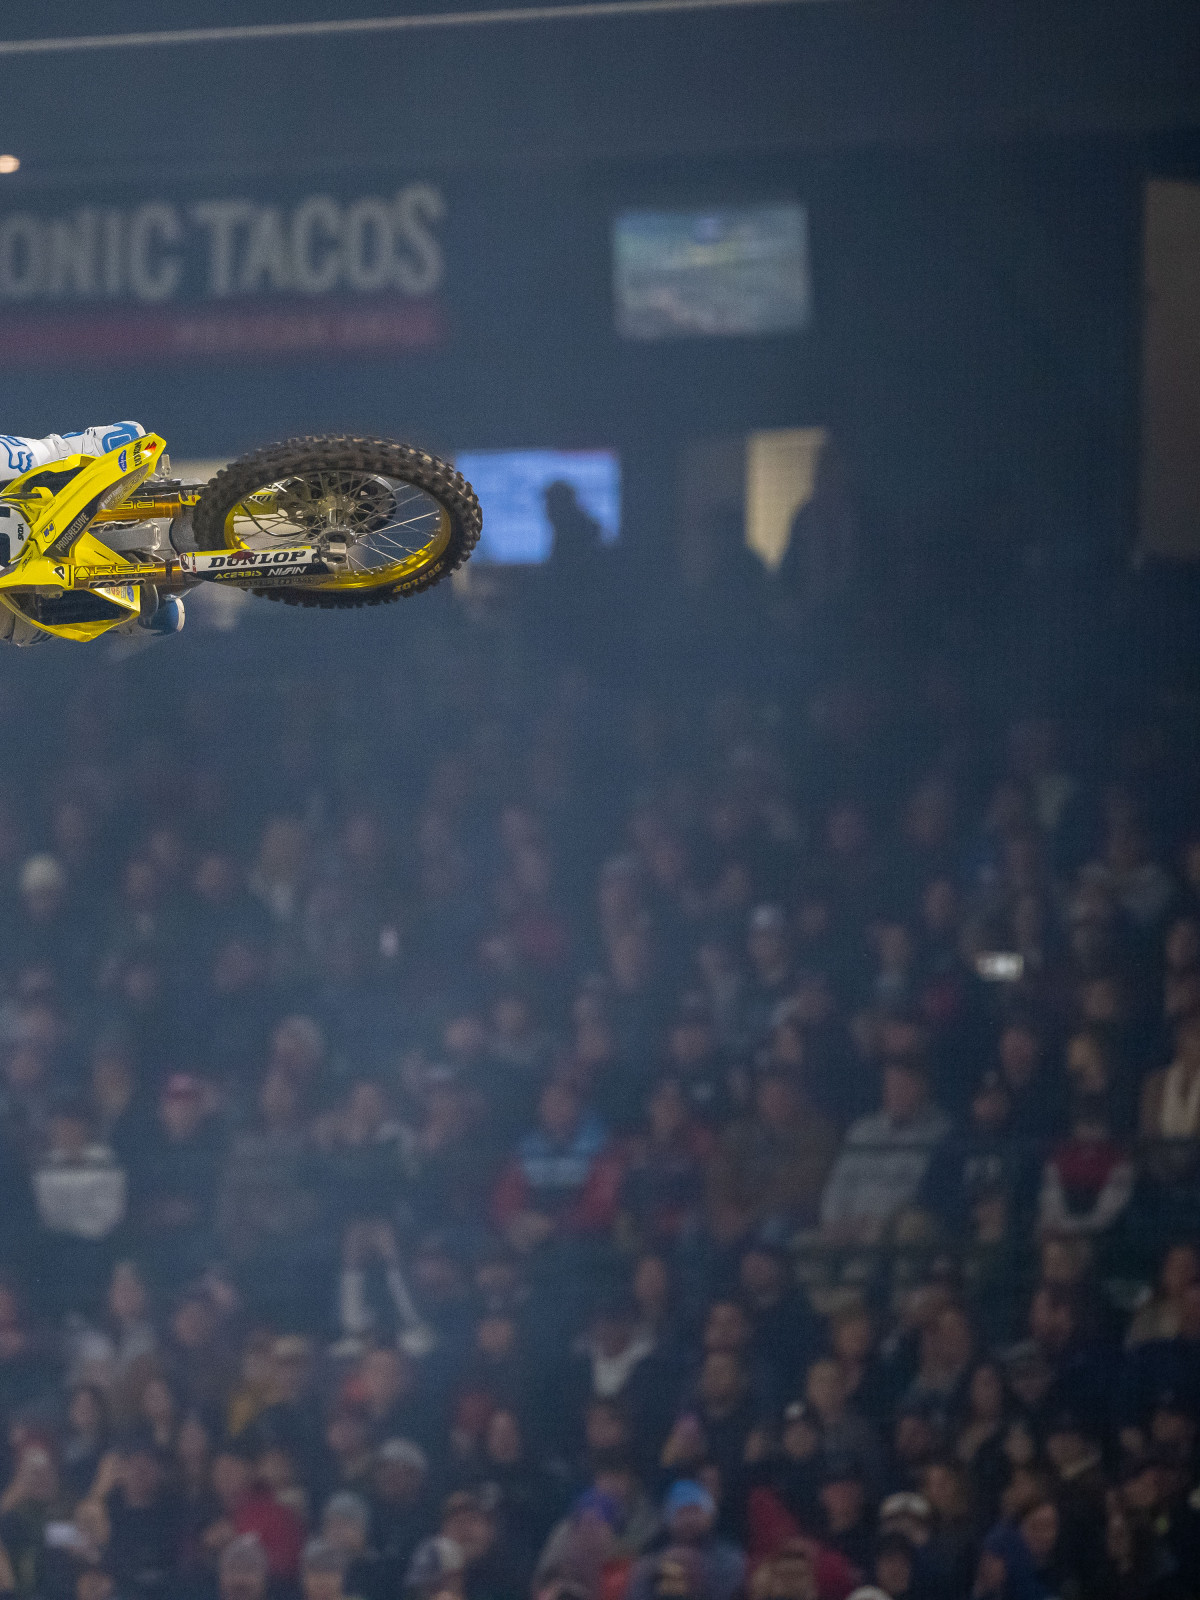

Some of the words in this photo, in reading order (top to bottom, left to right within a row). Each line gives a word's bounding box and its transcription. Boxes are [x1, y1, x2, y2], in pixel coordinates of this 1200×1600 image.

[193, 182, 446, 296] TACOS
[116, 498, 155, 510] RE
[55, 512, 89, 551] PROGRESSIVE
[208, 551, 306, 568] DUNLOP
[93, 563, 156, 575] REP
[267, 566, 306, 577] NISSIN
